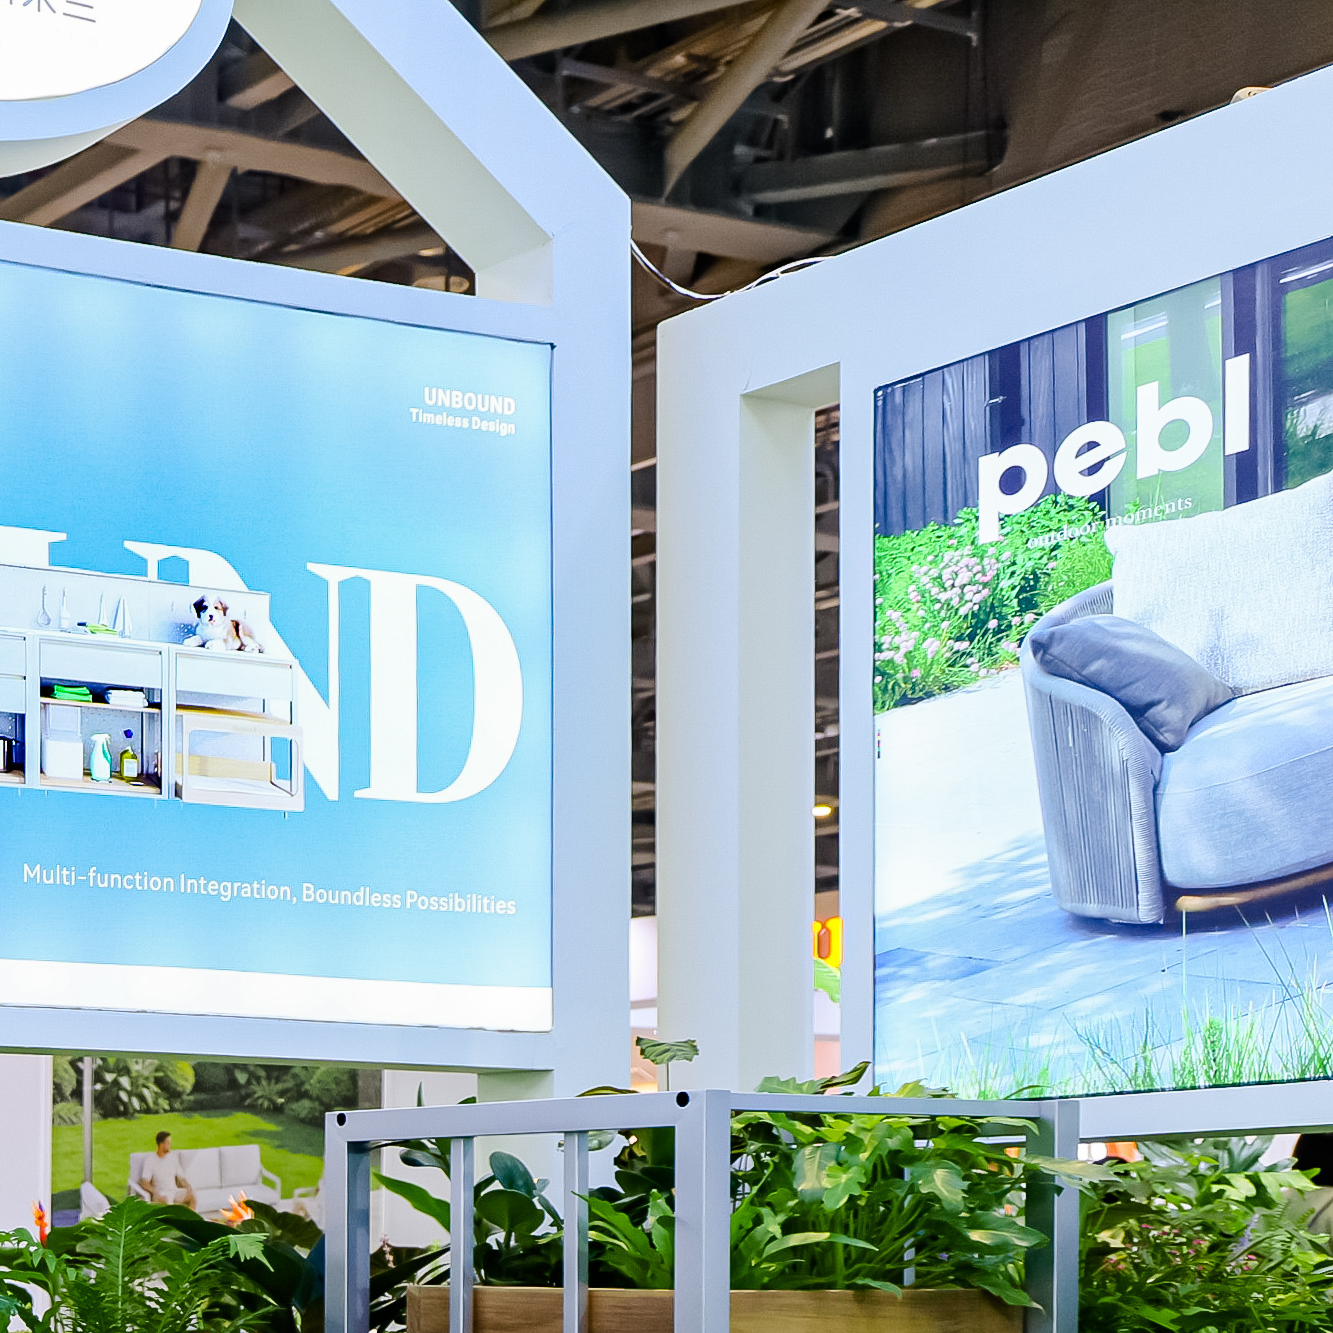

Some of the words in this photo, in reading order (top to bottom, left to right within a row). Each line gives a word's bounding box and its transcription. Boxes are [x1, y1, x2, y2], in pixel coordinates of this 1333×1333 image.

[409, 407, 469, 429] Timeless
[471, 416, 516, 437] Design
[423, 386, 516, 415] UNBOUND
[978, 353, 1250, 545] pebl
[1026, 520, 1101, 550] outdoor
[1105, 497, 1193, 532] moments
[22, 863, 175, 893] Multi-function
[179, 873, 297, 905] Integration,
[301, 882, 402, 910] Boundless
[406, 890, 517, 916] Possibilities
